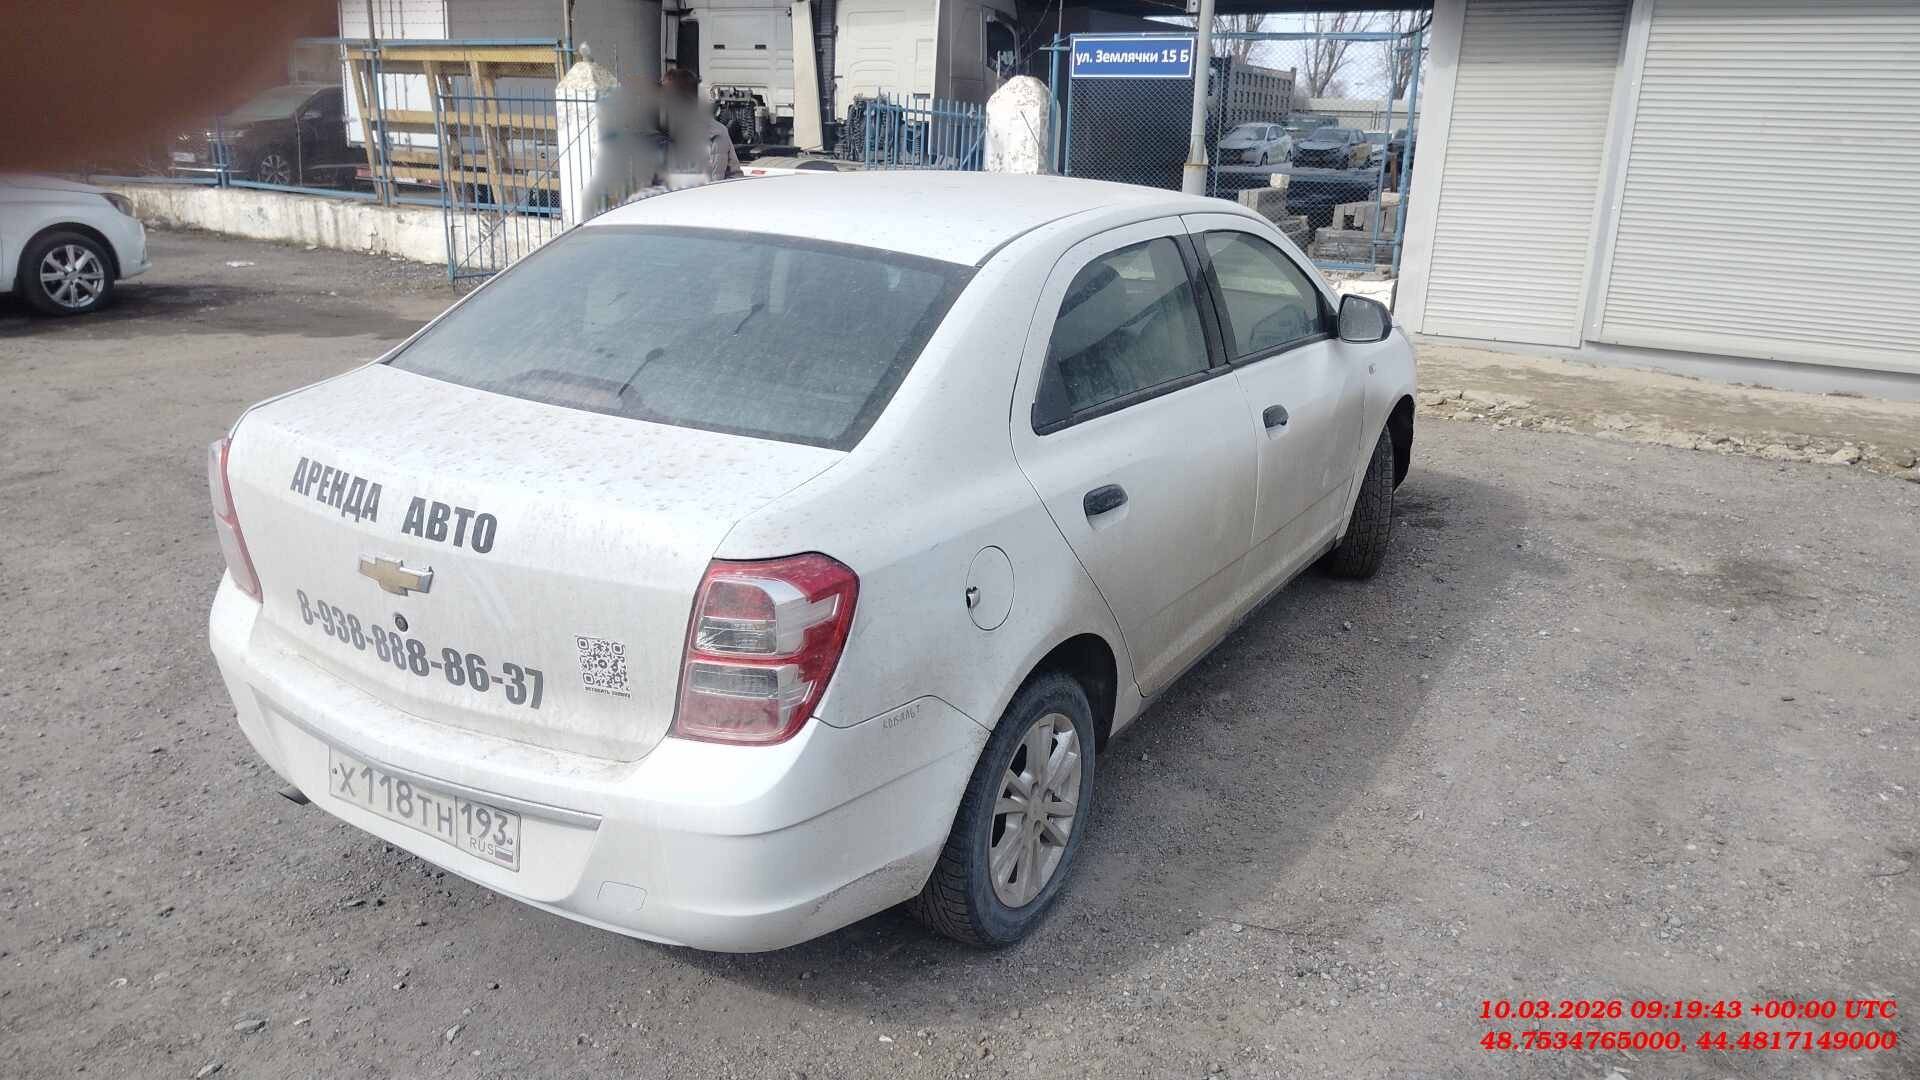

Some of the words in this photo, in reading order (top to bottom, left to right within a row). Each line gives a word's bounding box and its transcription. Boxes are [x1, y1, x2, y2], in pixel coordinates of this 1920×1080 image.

[1076, 51, 1093, 66] ул.
[1096, 50, 1159, 63] Землячки
[1161, 49, 1177, 63] 15
[1180, 49, 1189, 63] Б
[290, 456, 383, 523] АРЕНДА
[401, 496, 498, 554] АВТО
[296, 588, 544, 710] 8-938-888-86-37
[461, 803, 508, 846] 193
[469, 837, 495, 856] RUS
